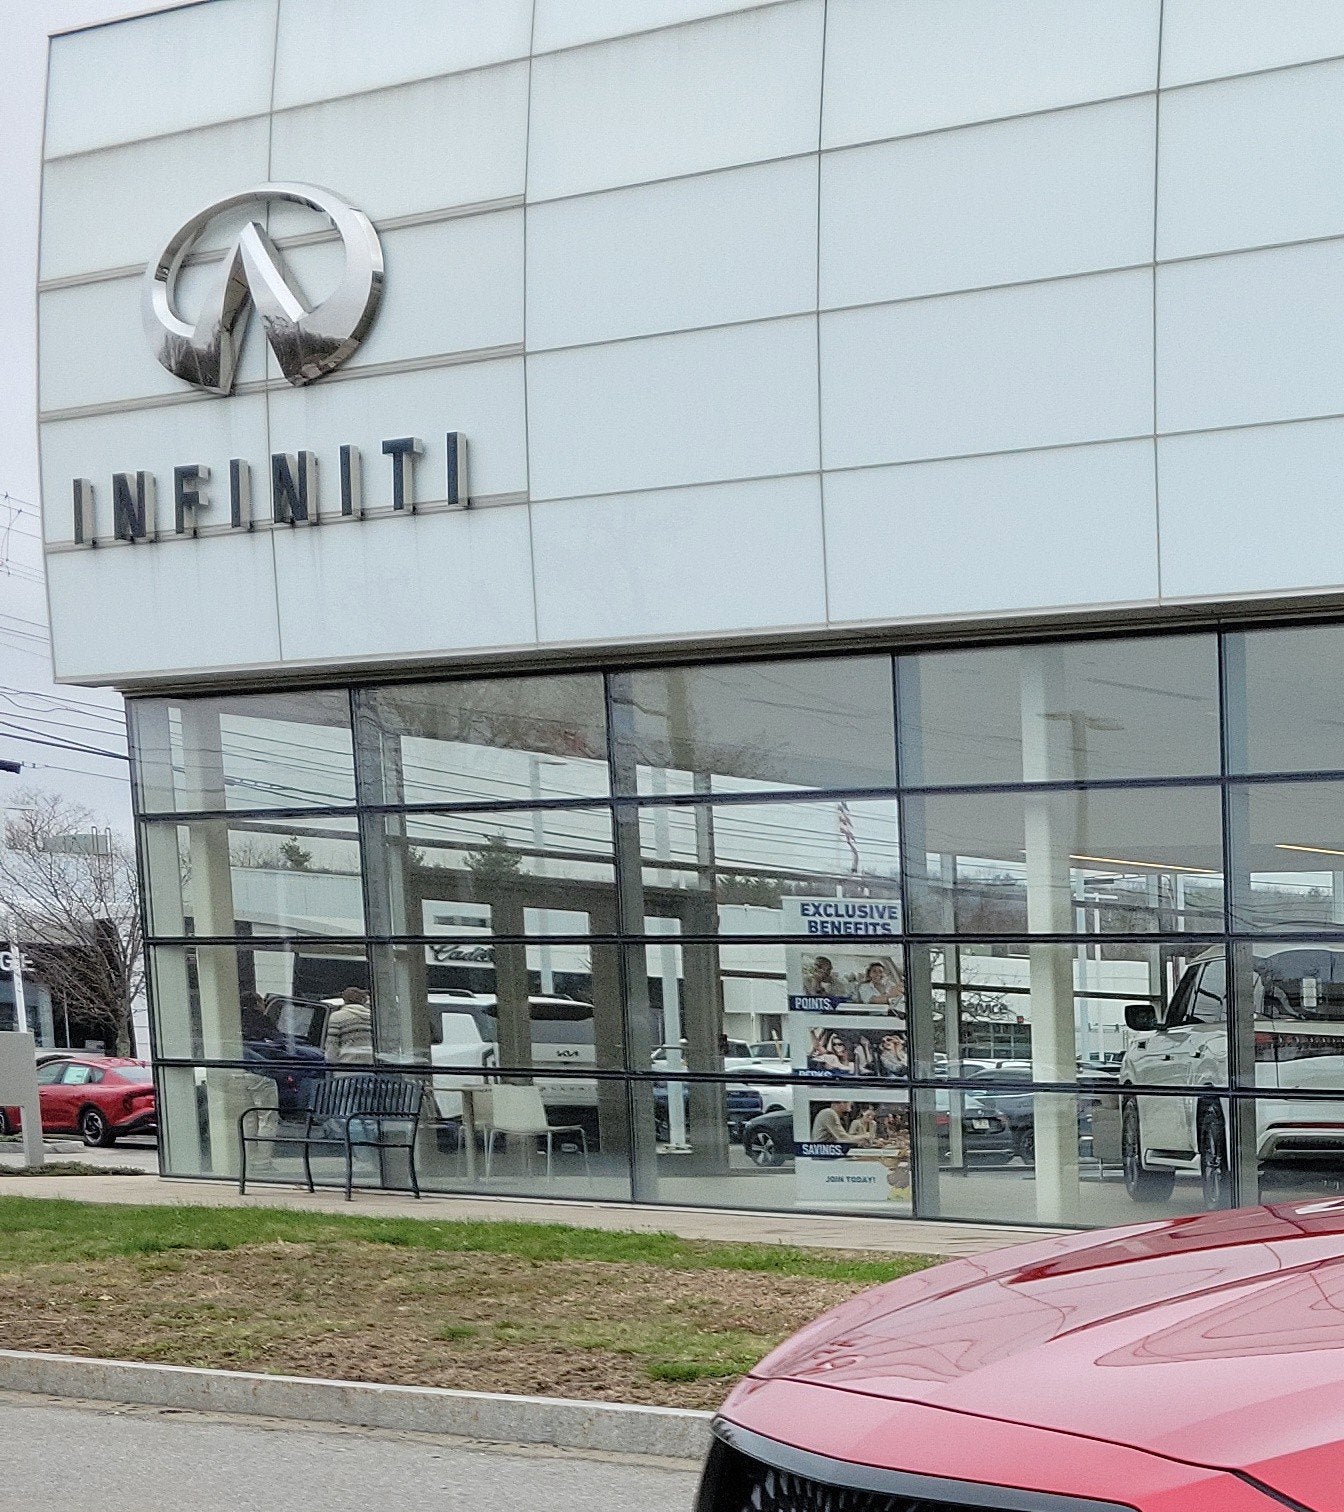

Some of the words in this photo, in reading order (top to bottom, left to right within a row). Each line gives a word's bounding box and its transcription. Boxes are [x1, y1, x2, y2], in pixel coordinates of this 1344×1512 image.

[73, 431, 469, 545] INFINITI
[801, 902, 898, 919] EXCLUSIVE
[808, 920, 892, 934] BENEFITS
[826, 1175, 844, 1183] JOIN
[846, 1175, 876, 1183] TODAY!
